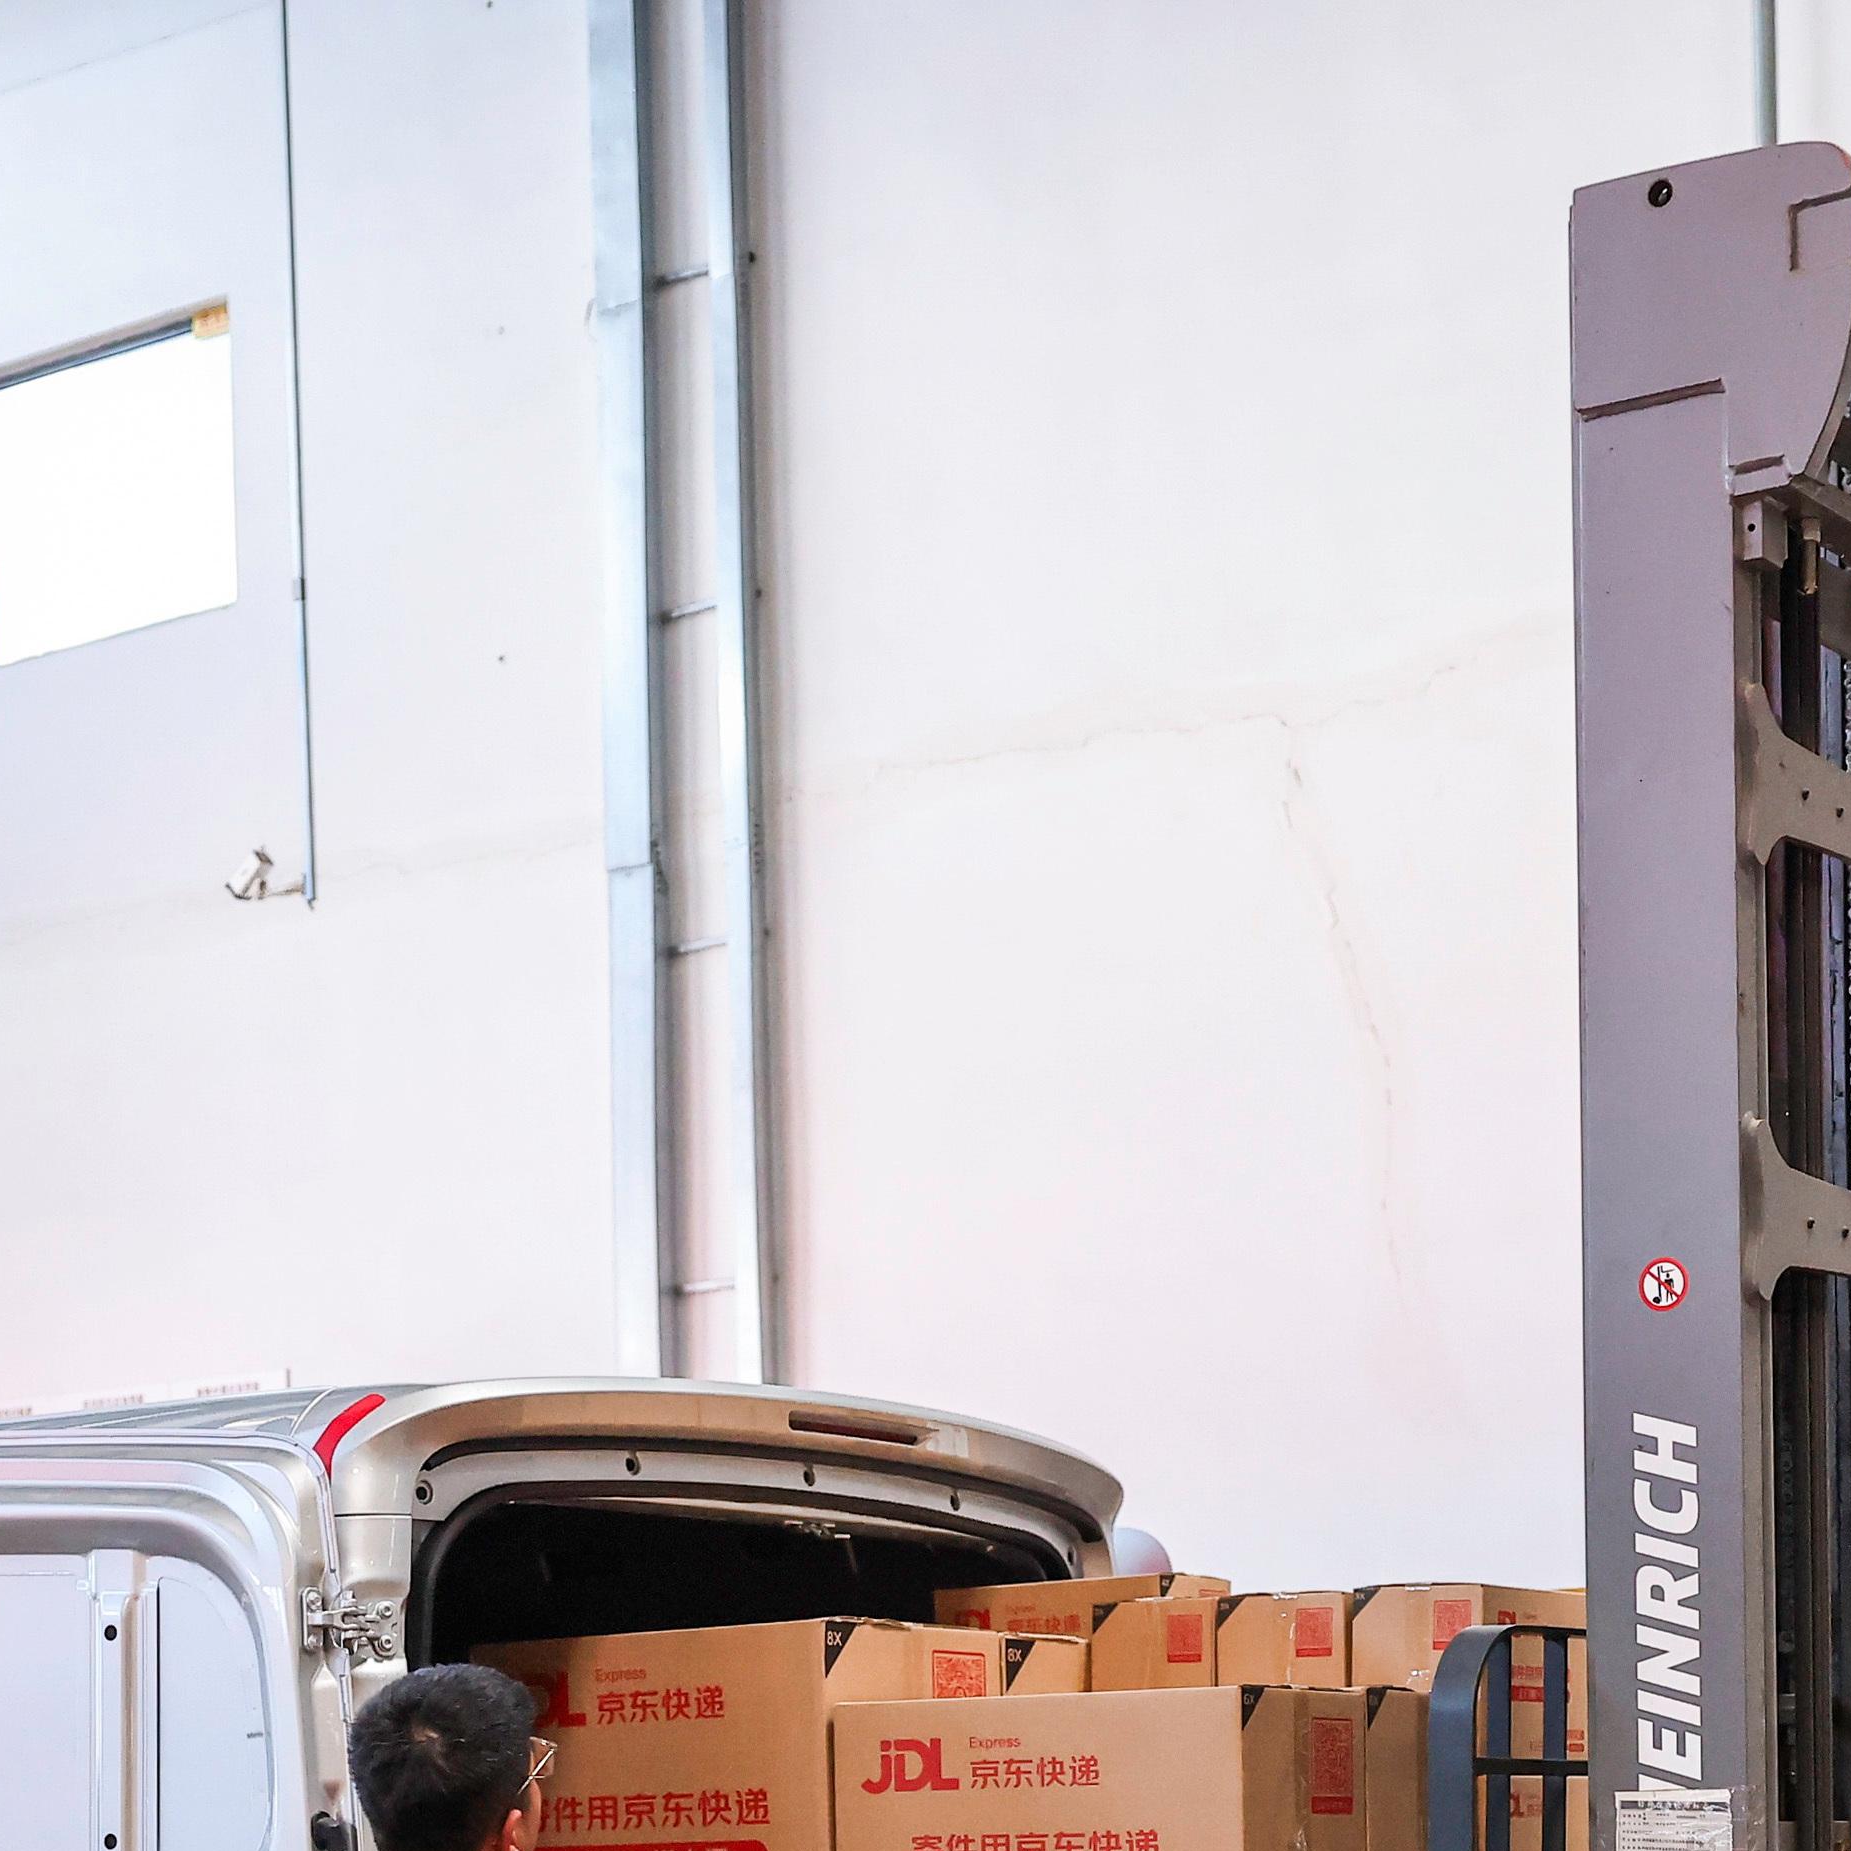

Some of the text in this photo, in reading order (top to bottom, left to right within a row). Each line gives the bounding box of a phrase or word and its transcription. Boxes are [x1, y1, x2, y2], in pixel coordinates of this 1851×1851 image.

[826, 1630, 843, 1647] 8X
[595, 1667, 647, 1683] Express
[596, 1685, 726, 1726] 京东快递
[969, 1735, 1022, 1751] Express
[860, 1737, 960, 1795] JDL
[969, 1754, 1101, 1790] 京东快递
